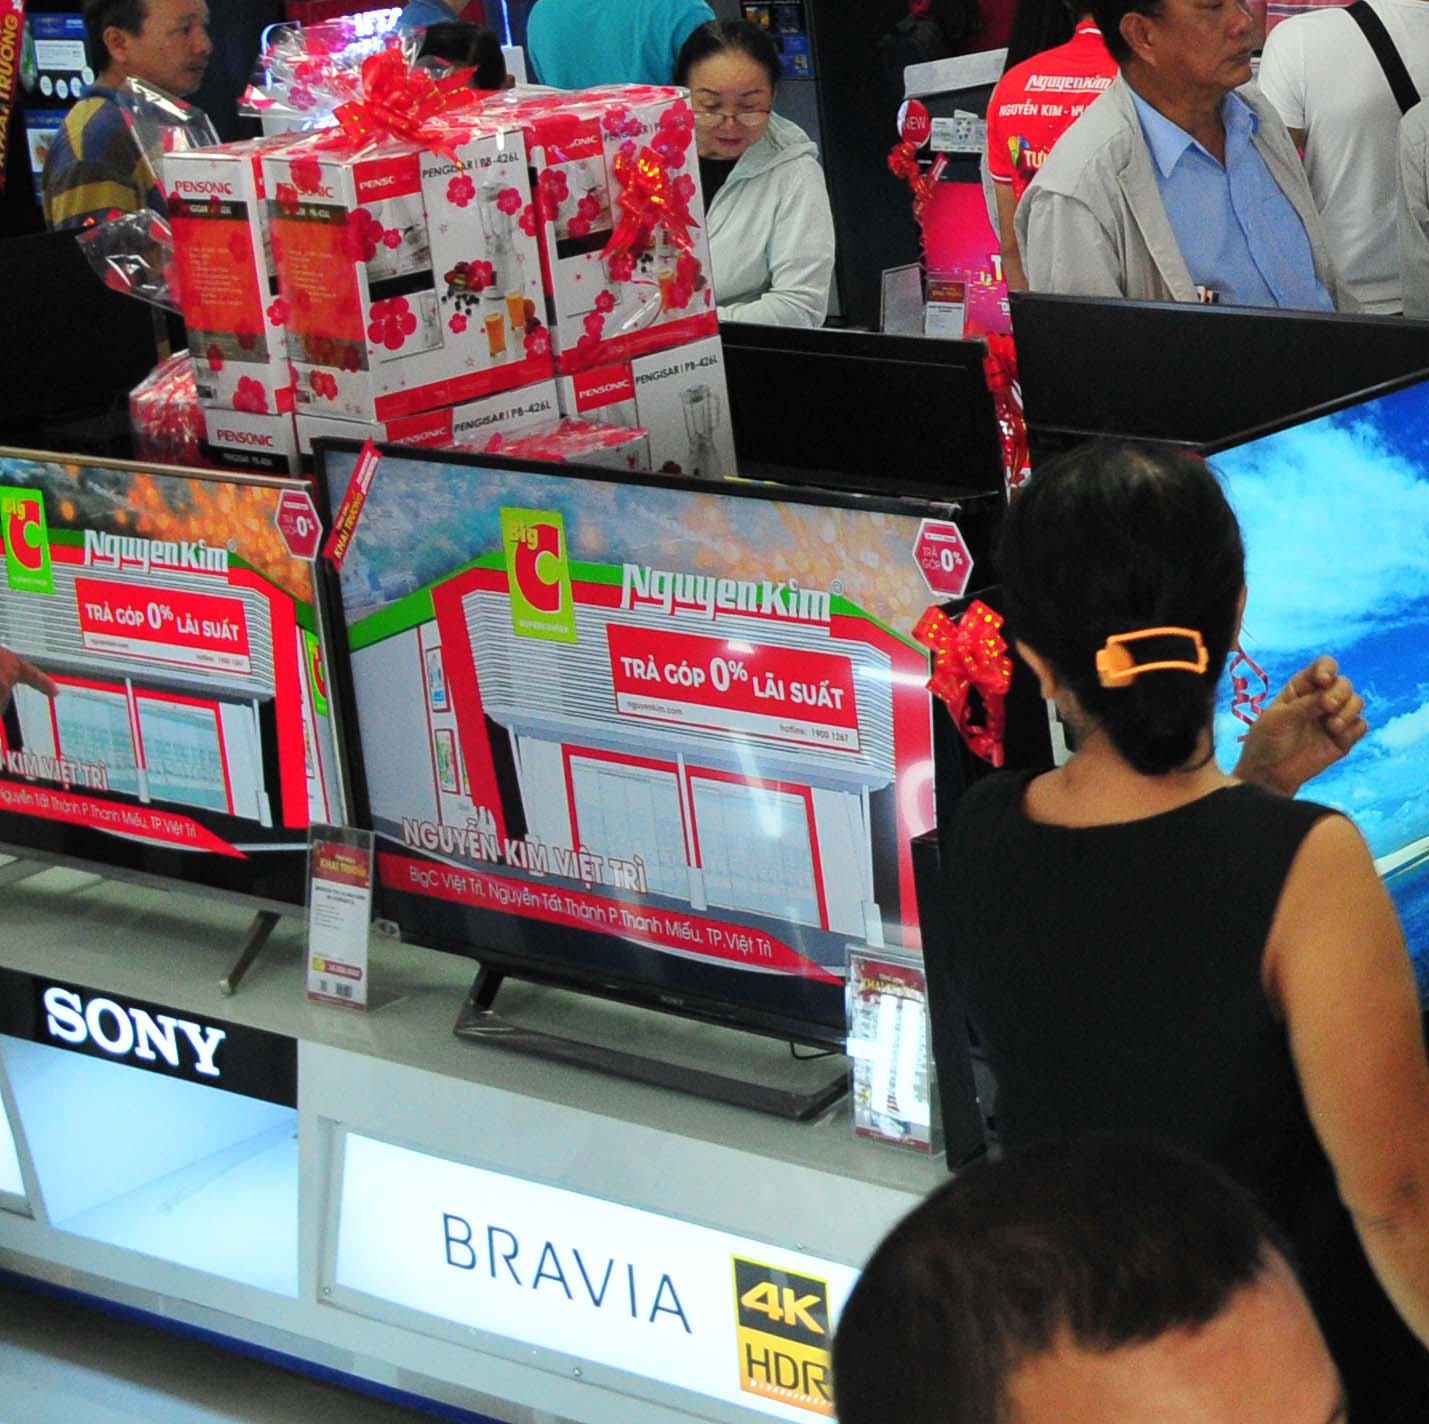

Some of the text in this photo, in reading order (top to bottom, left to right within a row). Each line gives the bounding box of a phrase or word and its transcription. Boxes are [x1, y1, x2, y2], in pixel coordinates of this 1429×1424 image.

[1024, 74, 1116, 94] NguyenKim
[1041, 105, 1062, 116] KIM
[175, 179, 233, 195] PENSONIC
[579, 379, 630, 399] PENSONIC
[635, 356, 719, 385] PENGISAR PB-426L
[454, 400, 552, 433] PENGISAR PB-426L
[217, 428, 273, 447] PENSONIC
[84, 529, 230, 575] NguyenKim
[509, 520, 539, 548] Big
[620, 563, 831, 622] NguyenKim
[85, 601, 240, 643] TRẢ GÓP 0% LÃI SUẤT
[620, 654, 845, 711] TRẢ GÓP 0% LÃI SUẤT
[627, 701, 683, 717] nguyenkim.com
[811, 727, 830, 741] 1900
[8, 750, 109, 790] KIM VIỆT TRÌ
[401, 816, 648, 895] NGUYỄN KIM VIỆT TRÌ
[409, 865, 439, 888] BigC
[442, 870, 466, 895] Việt
[489, 885, 540, 912] Nguyễn
[542, 891, 563, 915] Tất
[564, 897, 605, 922] Thành
[756, 937, 773, 959] Trì
[43, 987, 227, 1078] SONY
[442, 1212, 692, 1335] BRAVIA
[740, 1279, 829, 1335] 4K
[744, 1339, 834, 1394] HDR
